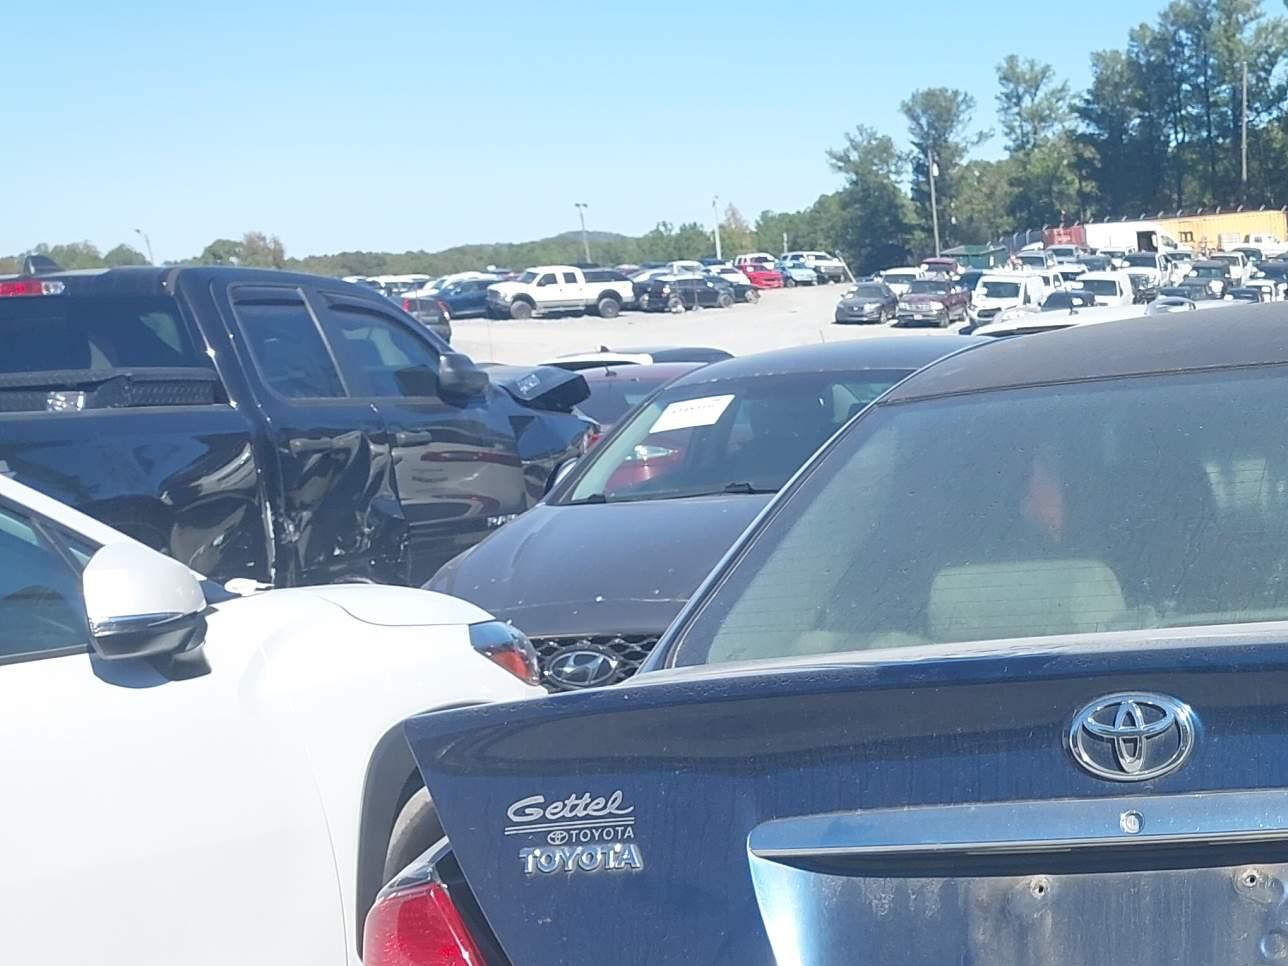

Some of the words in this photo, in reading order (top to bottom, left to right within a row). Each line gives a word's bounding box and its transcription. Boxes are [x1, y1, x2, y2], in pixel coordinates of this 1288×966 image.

[507, 790, 635, 822] Gettel
[570, 826, 634, 843] TOYOTA
[519, 843, 642, 874] TOYOTA
